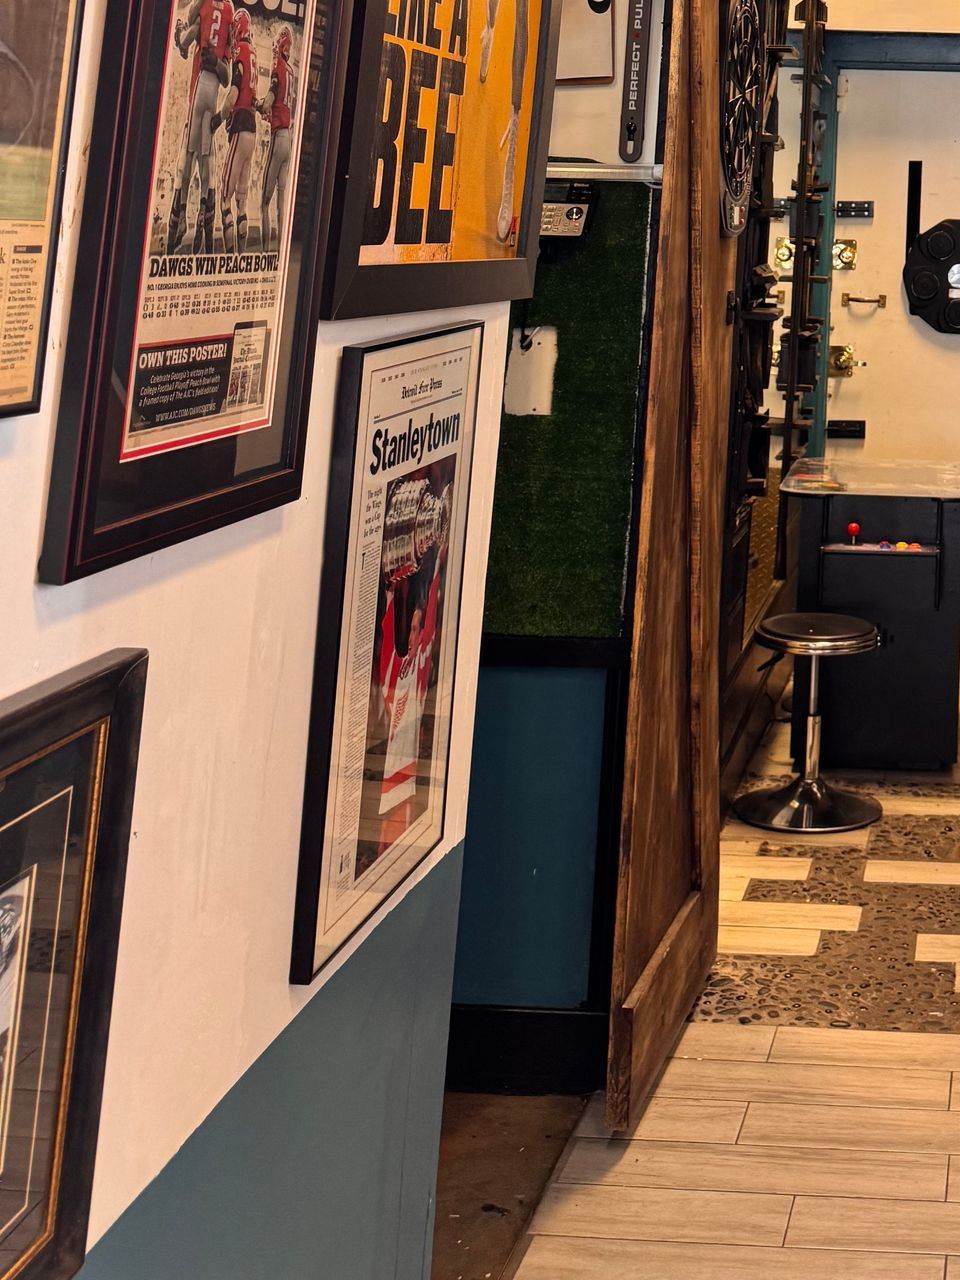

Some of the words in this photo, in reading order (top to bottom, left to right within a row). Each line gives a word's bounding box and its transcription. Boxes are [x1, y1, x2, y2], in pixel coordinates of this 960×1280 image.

[210, 10, 221, 46] 2
[629, 42, 641, 110] PERFECT
[360, 41, 467, 246] BEE
[150, 258, 193, 277] DAWGS
[196, 257, 217, 275] WIN
[218, 256, 252, 273] PEACH
[254, 254, 278, 271] BOWL
[139, 352, 164, 368] OWN
[166, 349, 188, 364] THIS
[190, 344, 227, 361] POSTER!
[371, 414, 459, 473] Stanleytown
